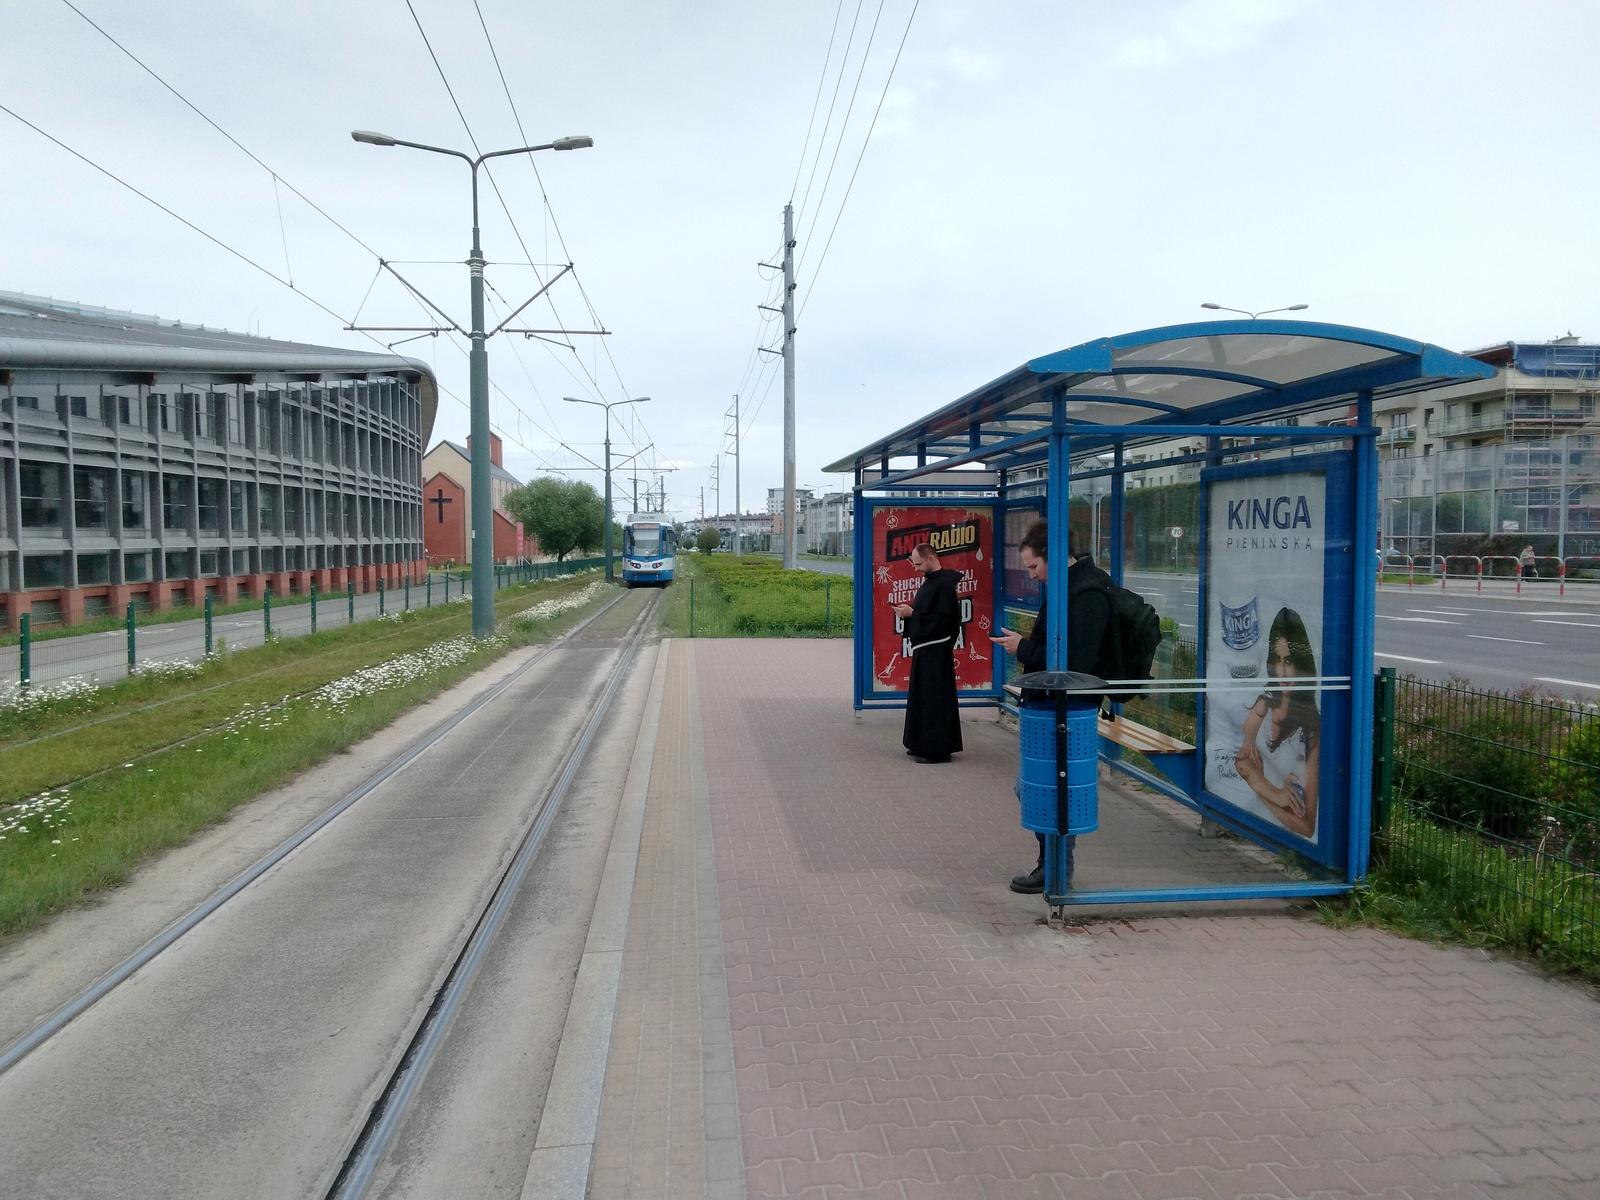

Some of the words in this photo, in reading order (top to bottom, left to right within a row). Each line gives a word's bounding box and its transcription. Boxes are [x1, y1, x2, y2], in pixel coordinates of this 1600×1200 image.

[1228, 495, 1312, 530] KINGA
[1227, 534, 1313, 550] PIENIŃSKA
[892, 576, 926, 592] SŁUCHA
[1224, 608, 1257, 632] KINGA
